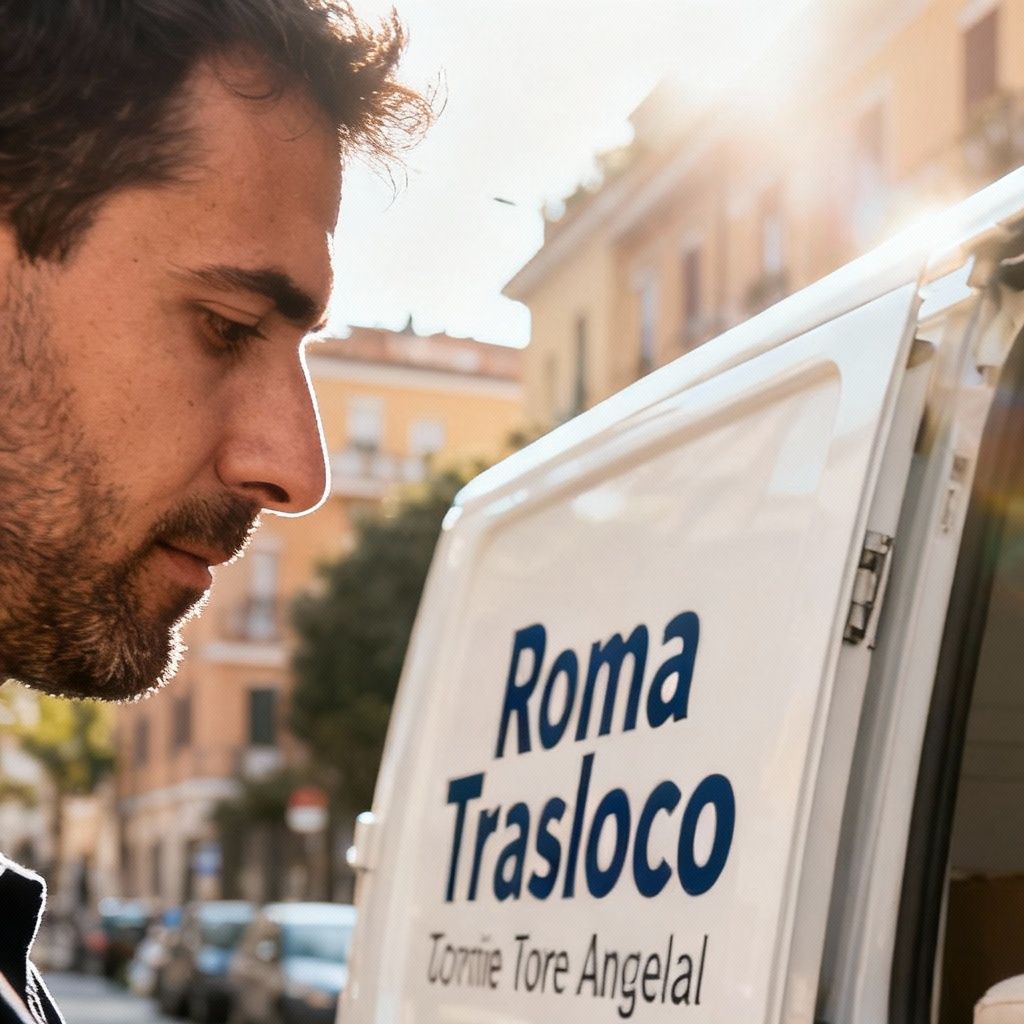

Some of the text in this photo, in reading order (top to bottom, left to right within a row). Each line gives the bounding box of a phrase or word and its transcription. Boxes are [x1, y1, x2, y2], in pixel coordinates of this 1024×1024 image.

[495, 611, 700, 759] Roma
[445, 752, 735, 902] Trasloco
[515, 934, 569, 994] Tore
[576, 933, 709, 1019] Angelal
